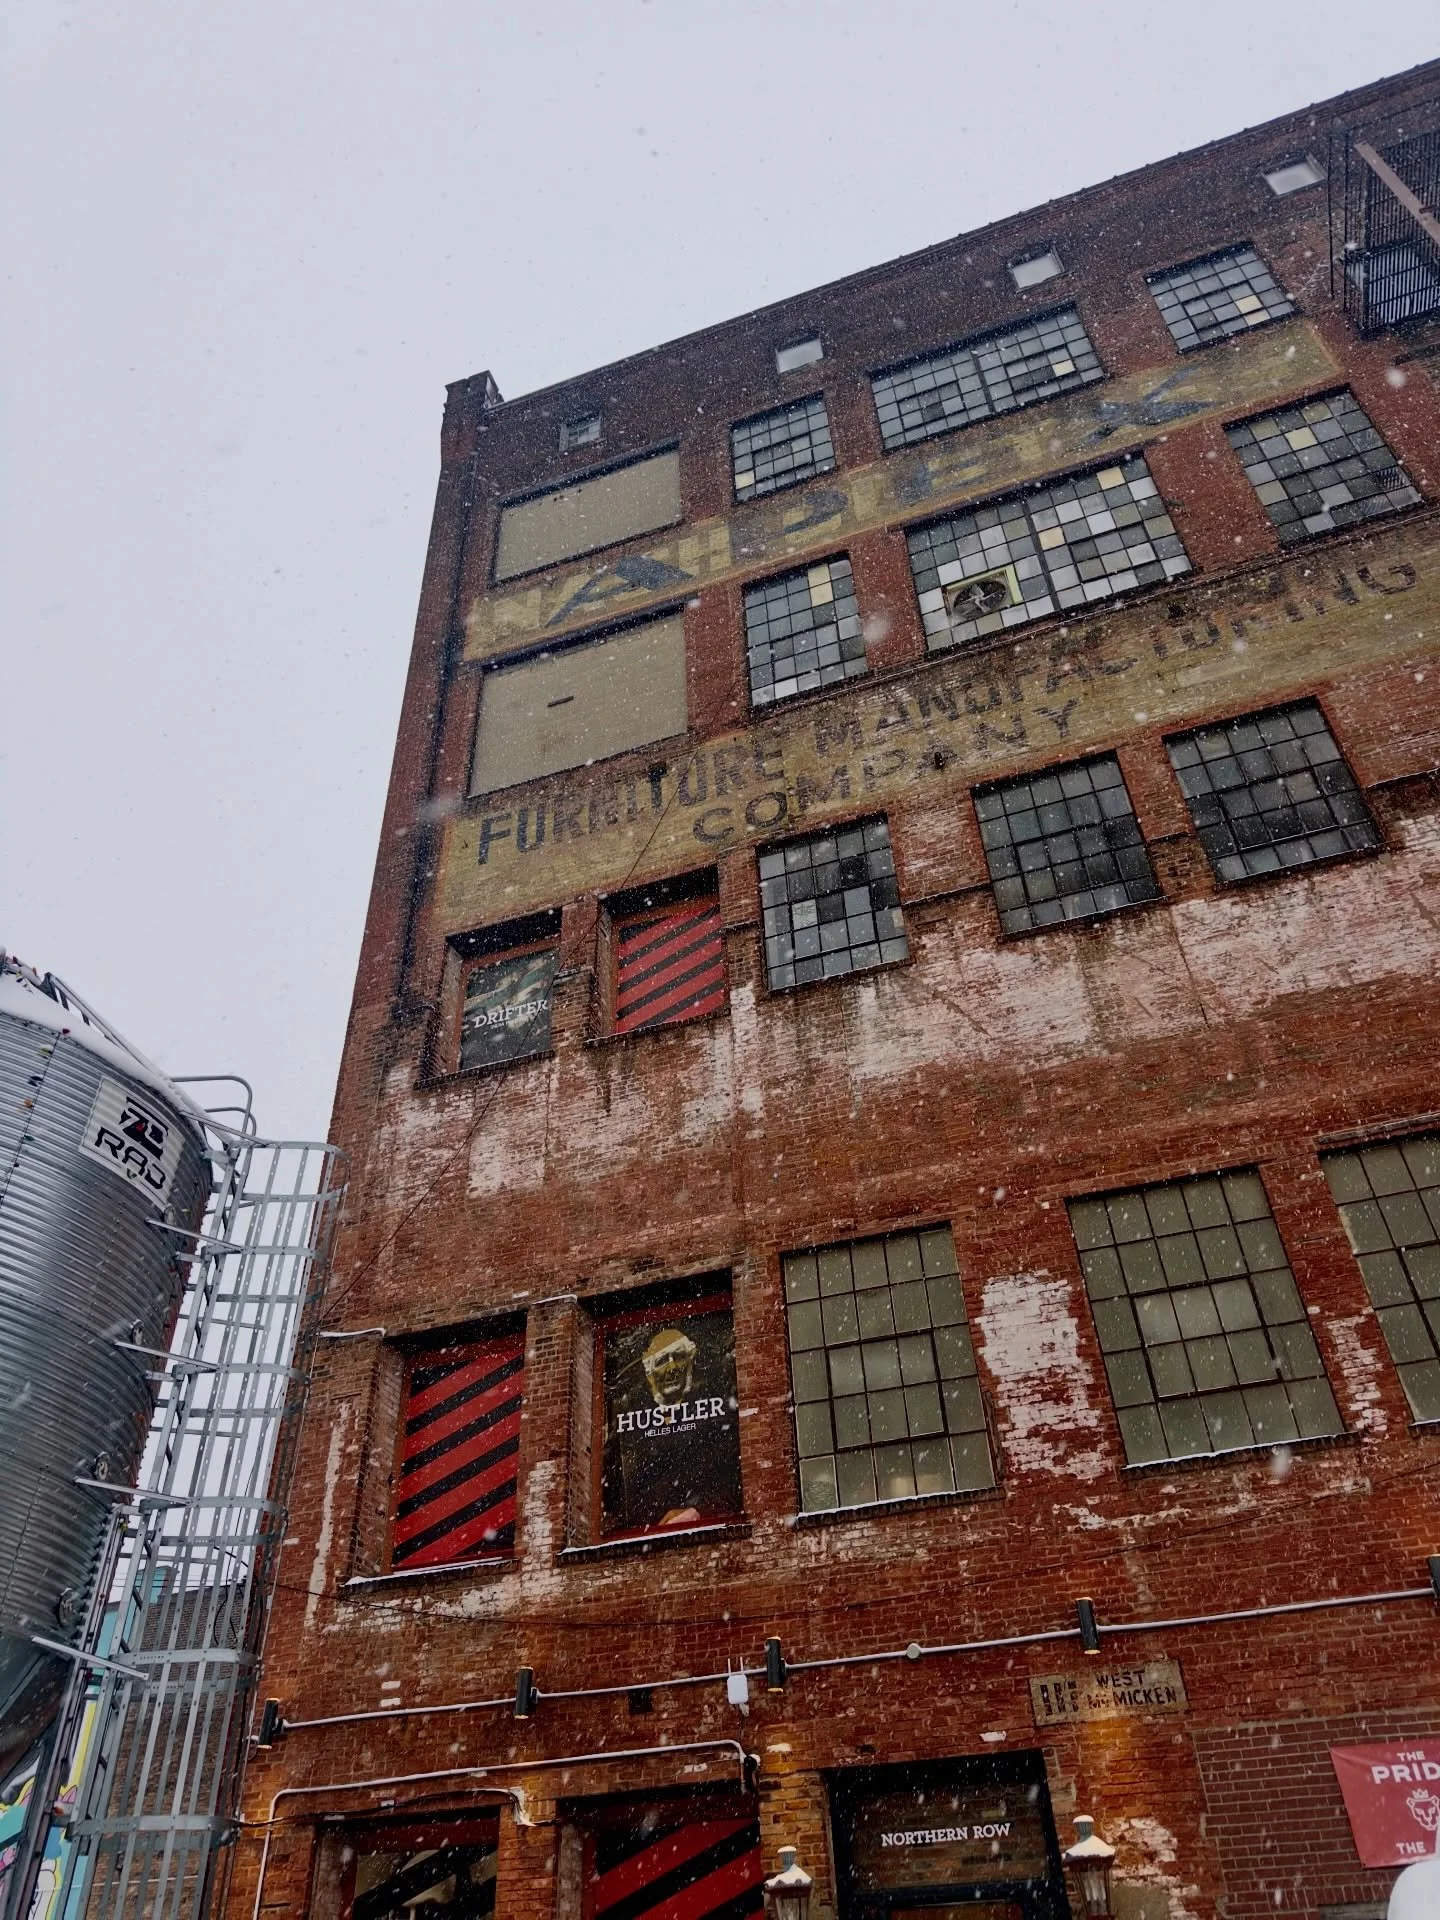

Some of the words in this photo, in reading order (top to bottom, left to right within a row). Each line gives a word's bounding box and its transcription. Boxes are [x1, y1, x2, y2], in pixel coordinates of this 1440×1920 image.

[692, 698, 1078, 846] COMPANY
[477, 736, 786, 866] FURNITURE
[471, 999, 548, 1029] DRIFTER
[94, 1126, 167, 1190] RAD
[616, 1397, 726, 1433] HUSTLER
[644, 1426, 671, 1438] HELLES
[672, 1422, 697, 1433] LAGER
[1096, 1669, 1146, 1689] WEST
[1397, 1750, 1426, 1761] THE
[880, 1826, 968, 1847] NORTHERN
[973, 1822, 1011, 1840] ROW
[1395, 1841, 1427, 1854] THE
